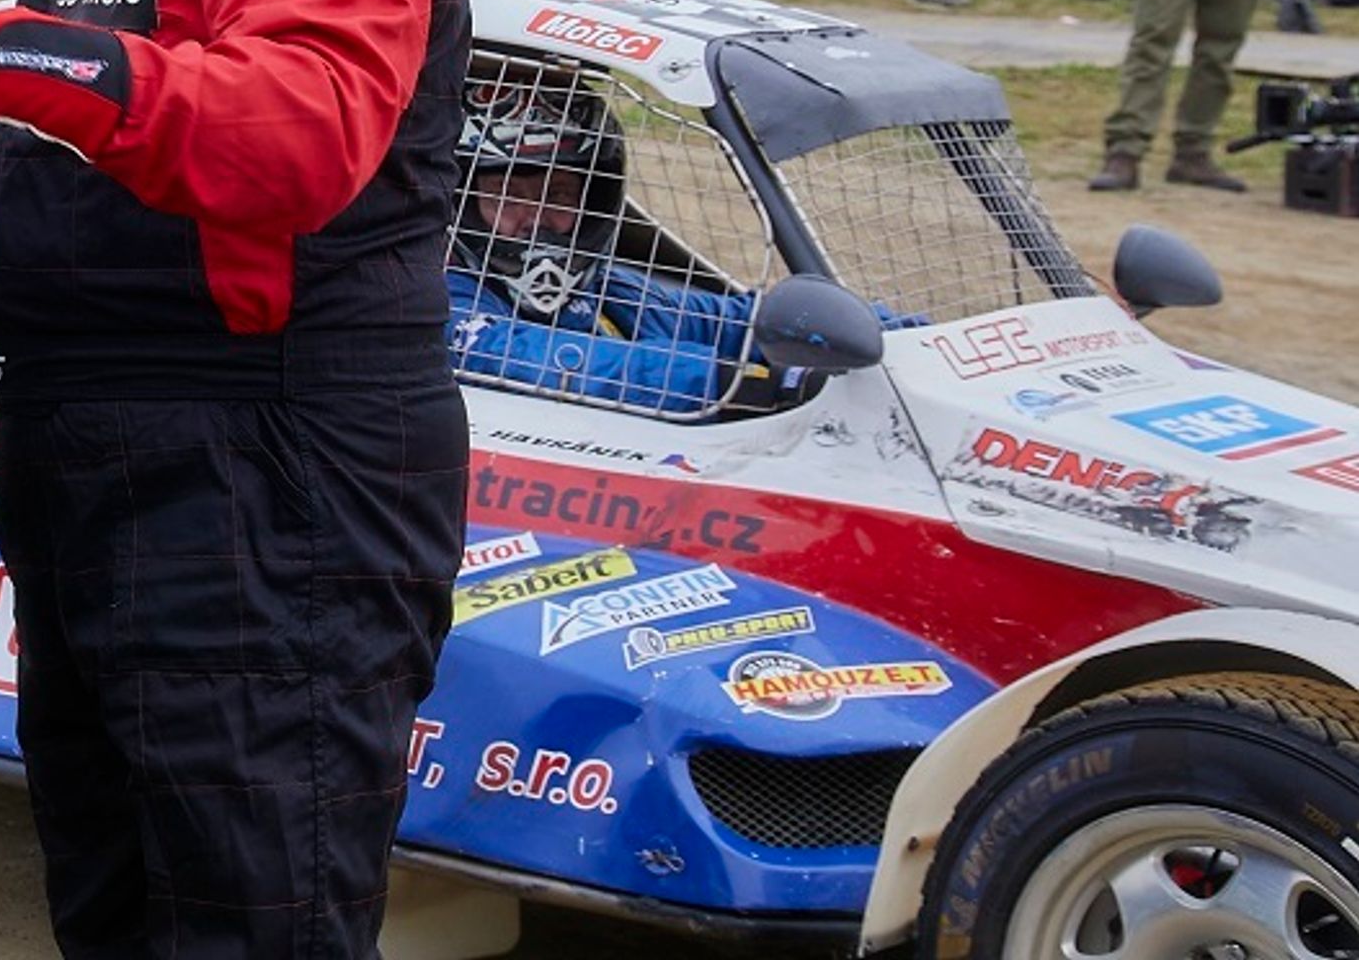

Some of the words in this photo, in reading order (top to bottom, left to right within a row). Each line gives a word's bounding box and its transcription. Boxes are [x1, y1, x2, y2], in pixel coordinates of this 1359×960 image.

[538, 14, 650, 55] MoTeC
[462, 539, 530, 568] trol
[610, 591, 719, 624] PARTNER
[733, 668, 881, 701] HAMOUZ
[476, 741, 618, 815] s.r.o.
